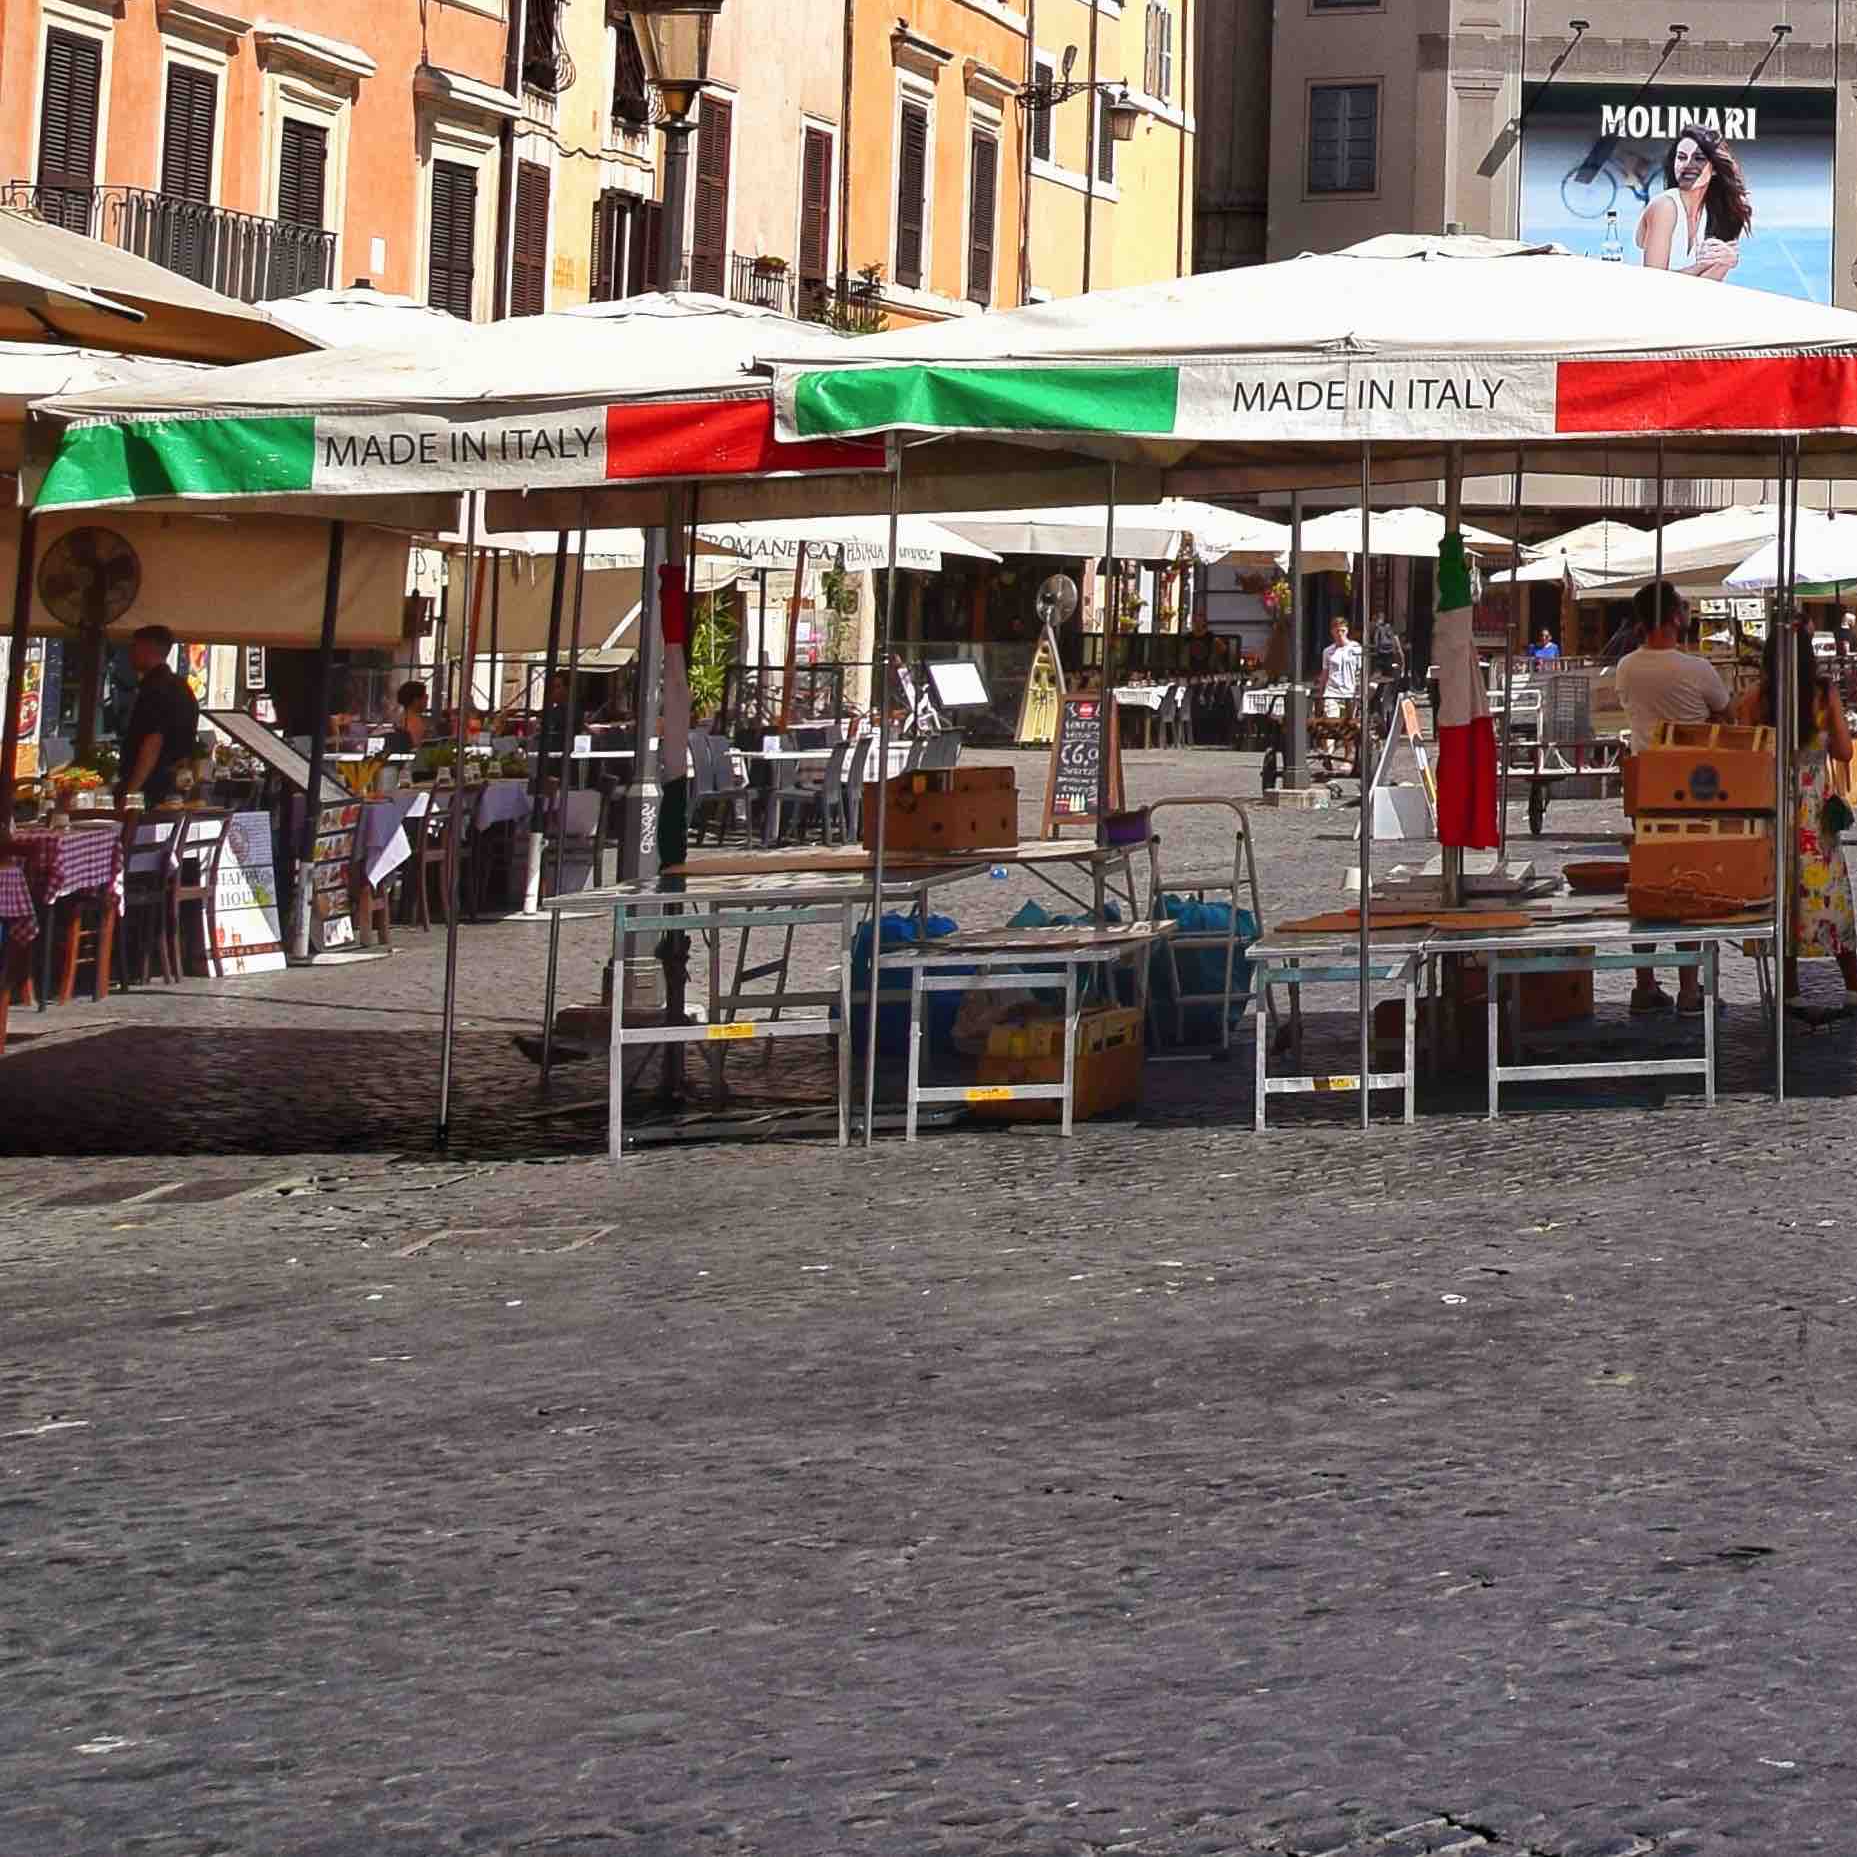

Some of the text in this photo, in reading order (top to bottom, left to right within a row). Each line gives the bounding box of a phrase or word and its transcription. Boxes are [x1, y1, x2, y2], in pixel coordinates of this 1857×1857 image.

[1601, 105, 1757, 140] MOLINARI
[1233, 378, 1505, 412] MADE IN ITALY
[325, 427, 598, 467] MADE IN ITALY
